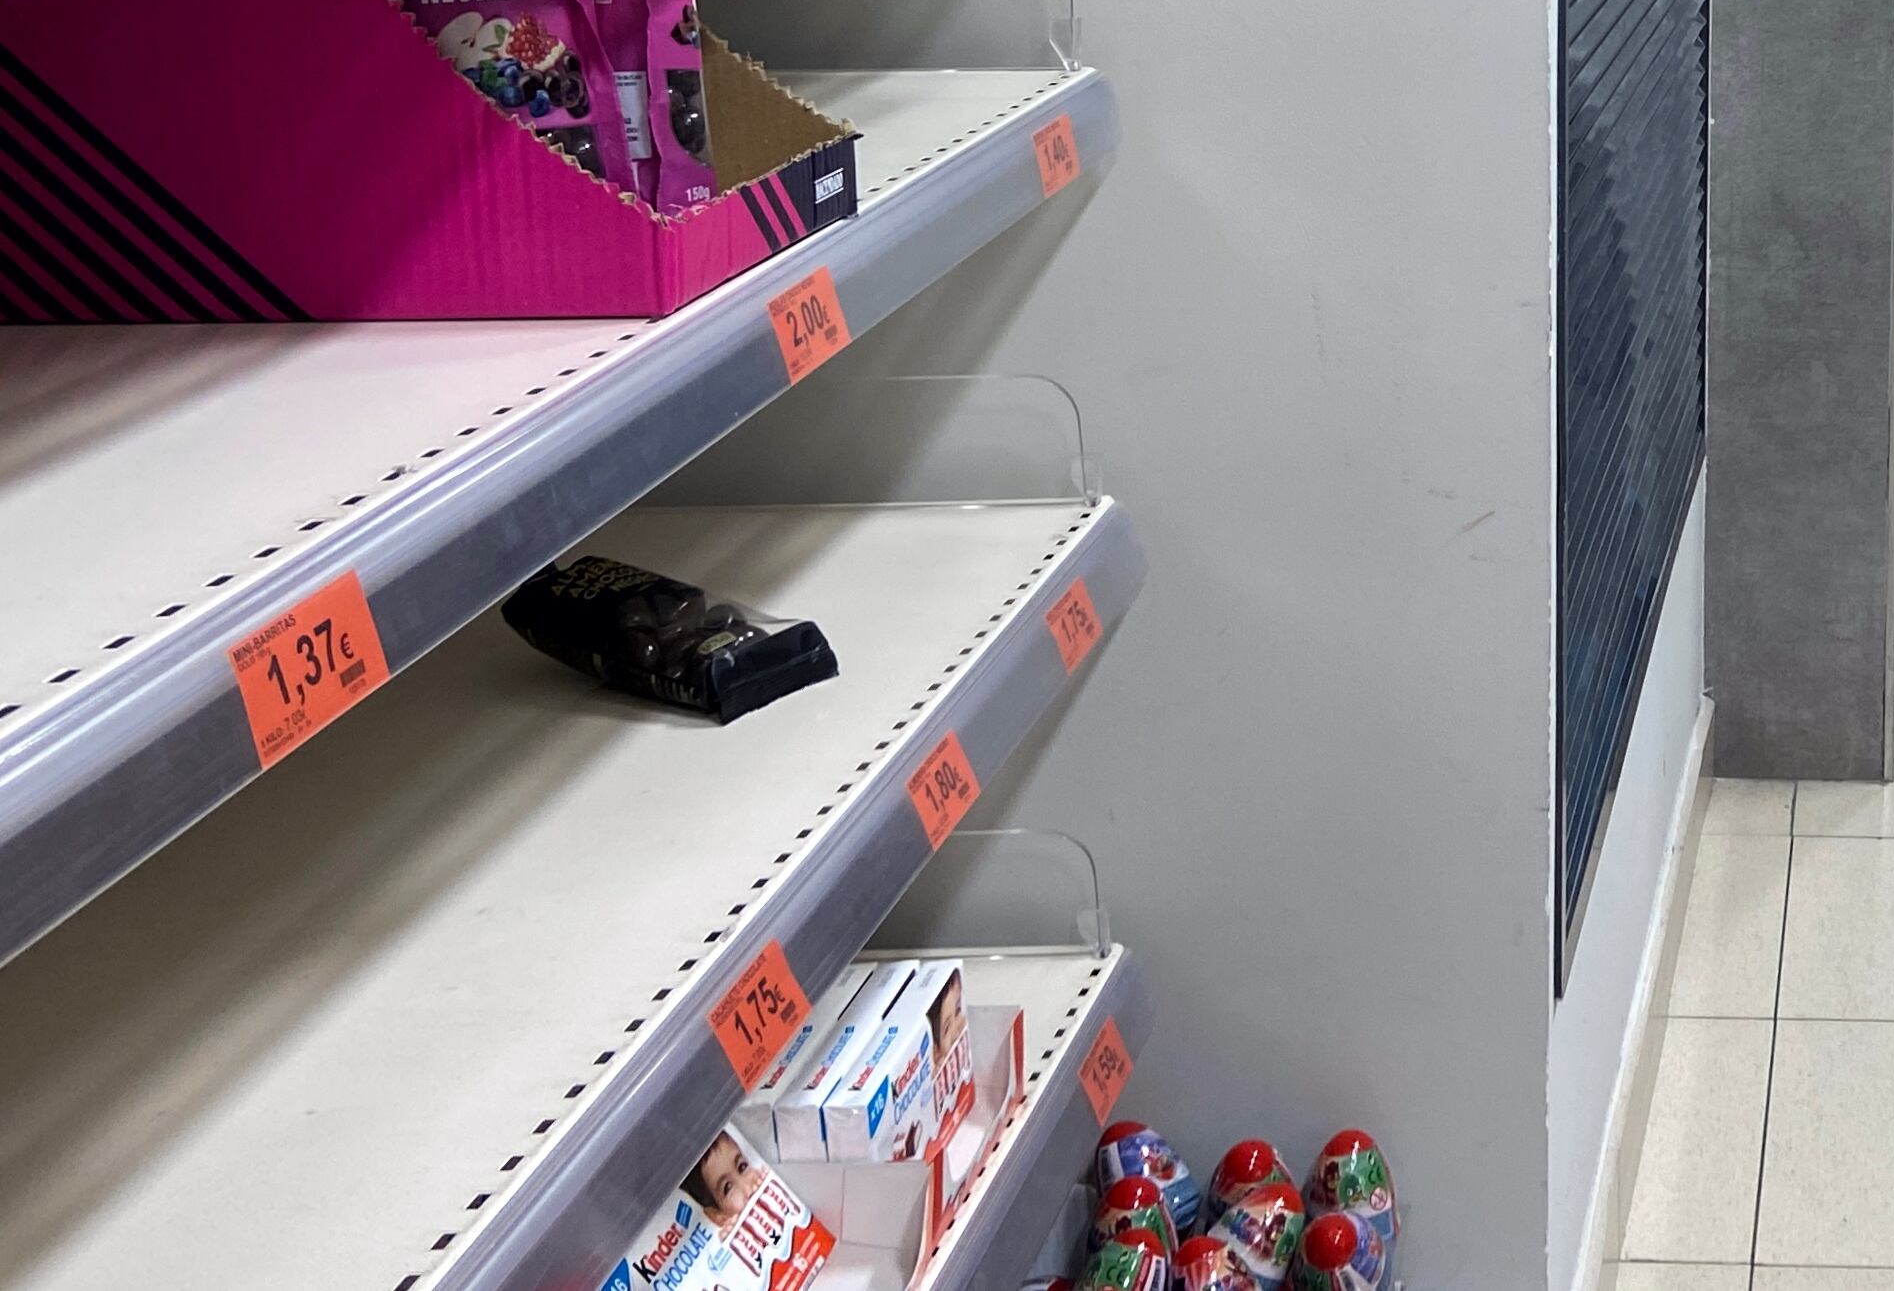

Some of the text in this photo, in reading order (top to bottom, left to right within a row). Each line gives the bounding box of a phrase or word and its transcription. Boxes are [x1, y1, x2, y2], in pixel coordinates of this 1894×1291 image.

[786, 294, 830, 351] 2,00€
[267, 617, 354, 706] 1,37€
[734, 976, 786, 1047] 1,75€
